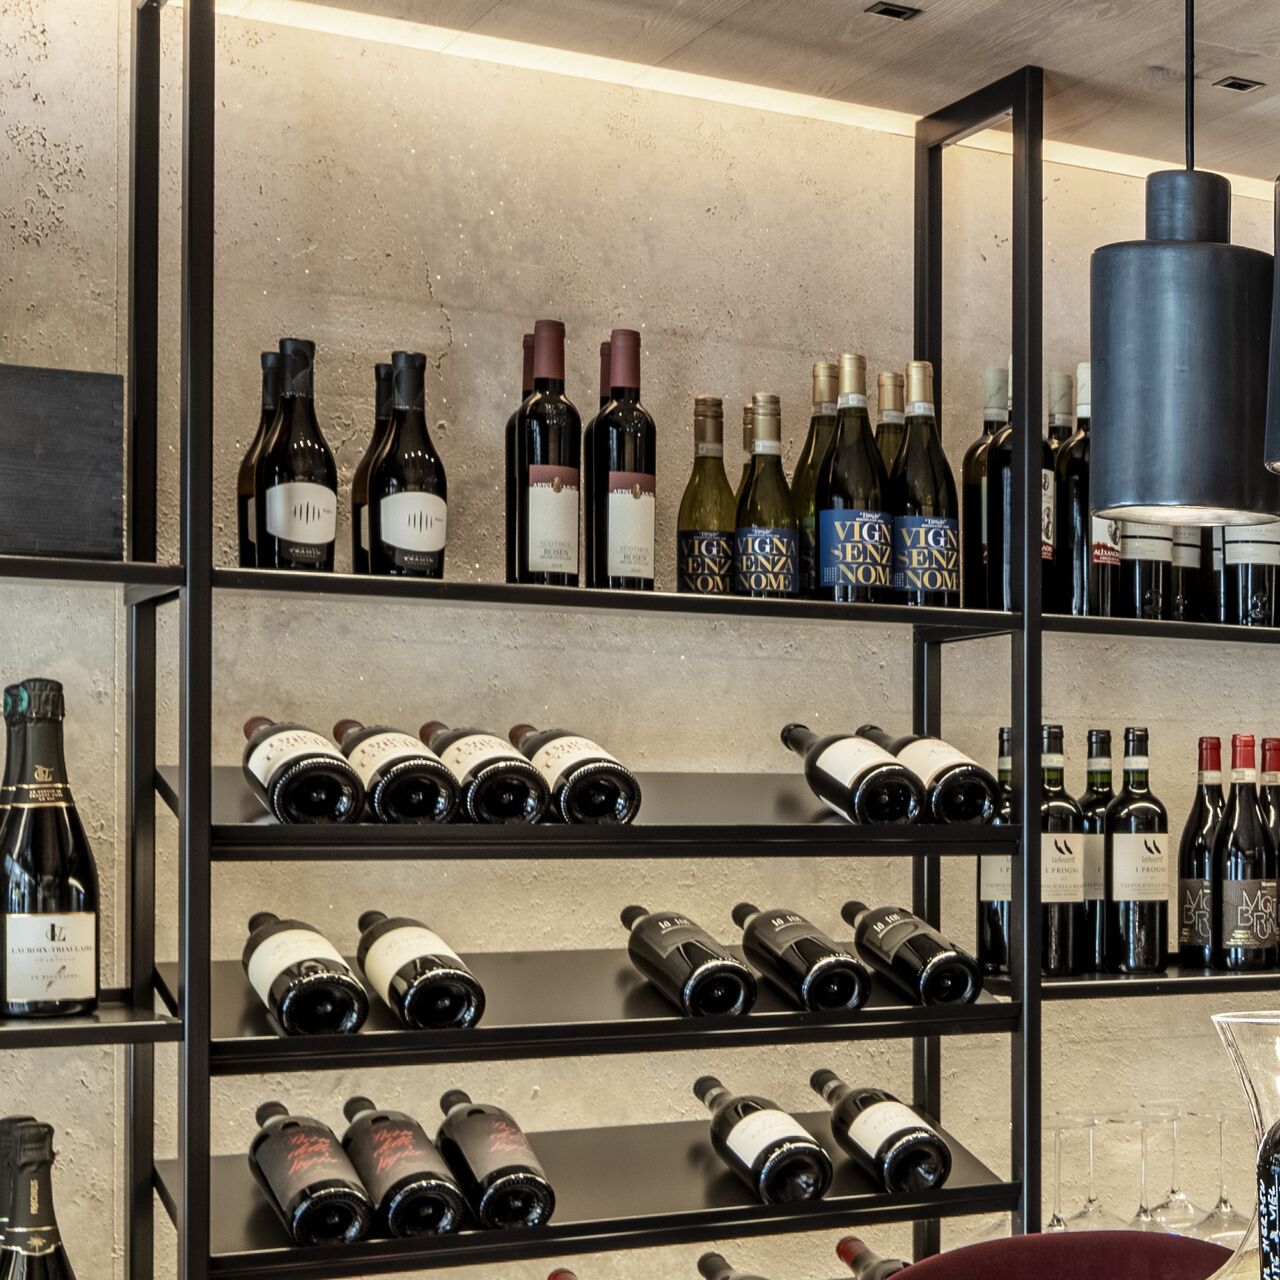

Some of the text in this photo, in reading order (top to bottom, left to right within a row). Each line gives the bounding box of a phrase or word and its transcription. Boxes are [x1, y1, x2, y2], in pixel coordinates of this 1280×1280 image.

[834, 521, 891, 542] VIGN
[901, 527, 958, 548] VIGN
[543, 548, 569, 556] ROSEN
[682, 540, 733, 557] VIGN
[830, 542, 891, 564] SENZ
[897, 548, 958, 570] SENZ
[683, 575, 731, 593] NOM
[837, 564, 892, 585] NOM
[905, 569, 958, 591] NOM
